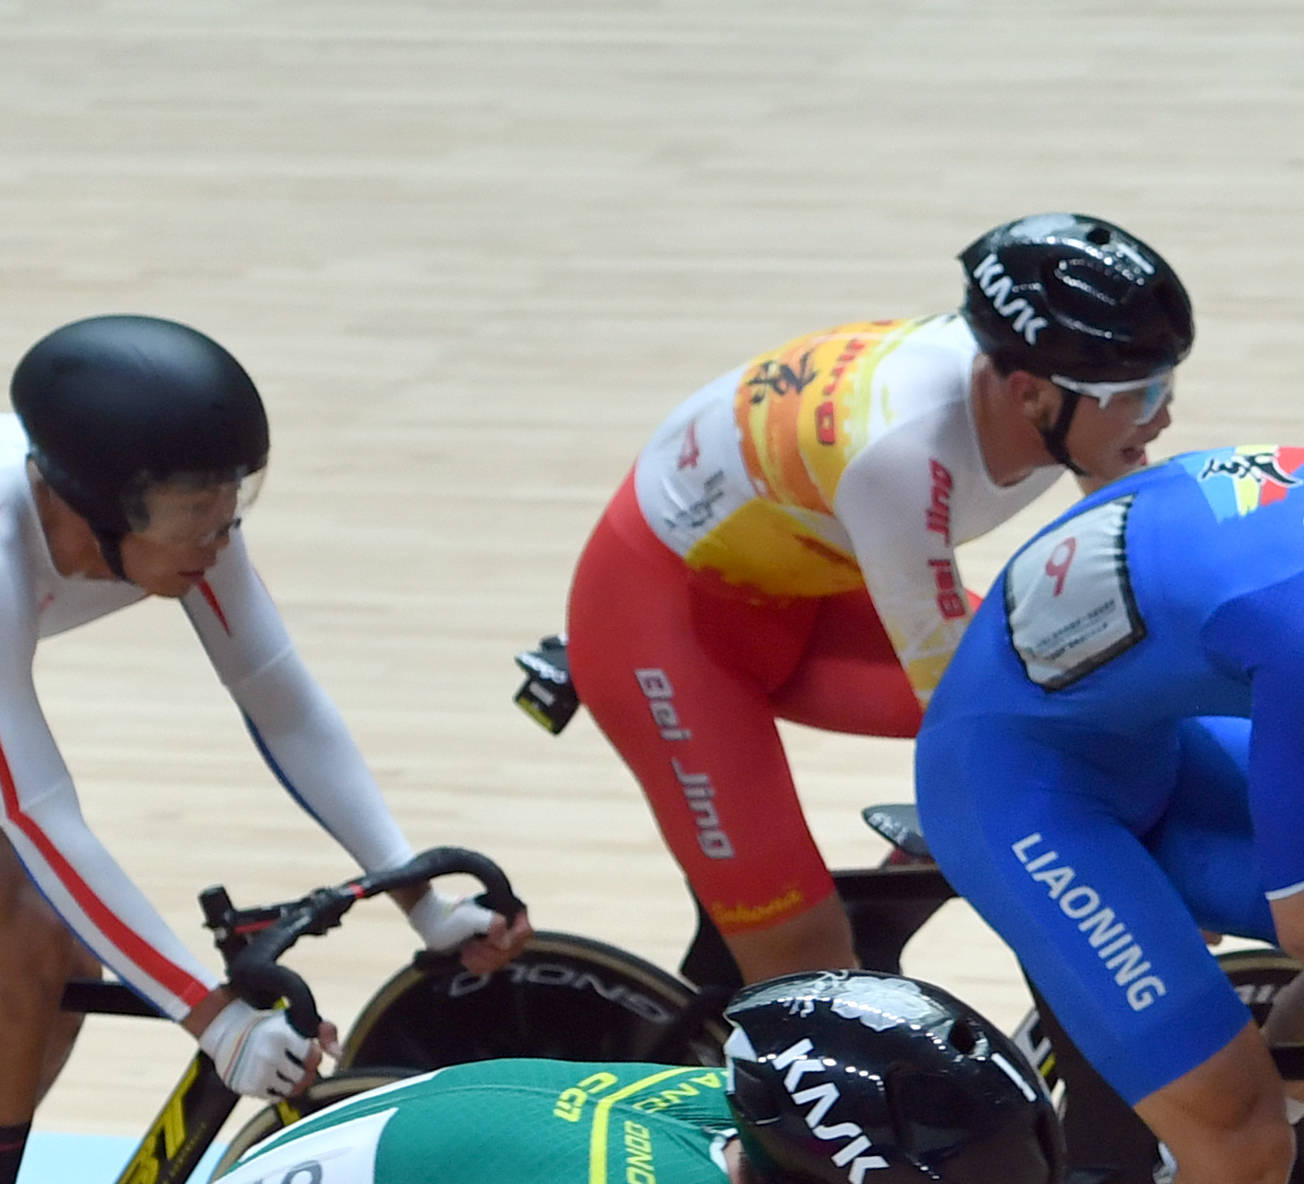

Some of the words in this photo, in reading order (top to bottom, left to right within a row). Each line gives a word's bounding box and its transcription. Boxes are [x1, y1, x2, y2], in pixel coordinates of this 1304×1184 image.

[1044, 536, 1078, 598] 9
[634, 668, 692, 741] Bei
[1011, 832, 1167, 1012] LIAONING
[631, 1071, 729, 1114] ANG
